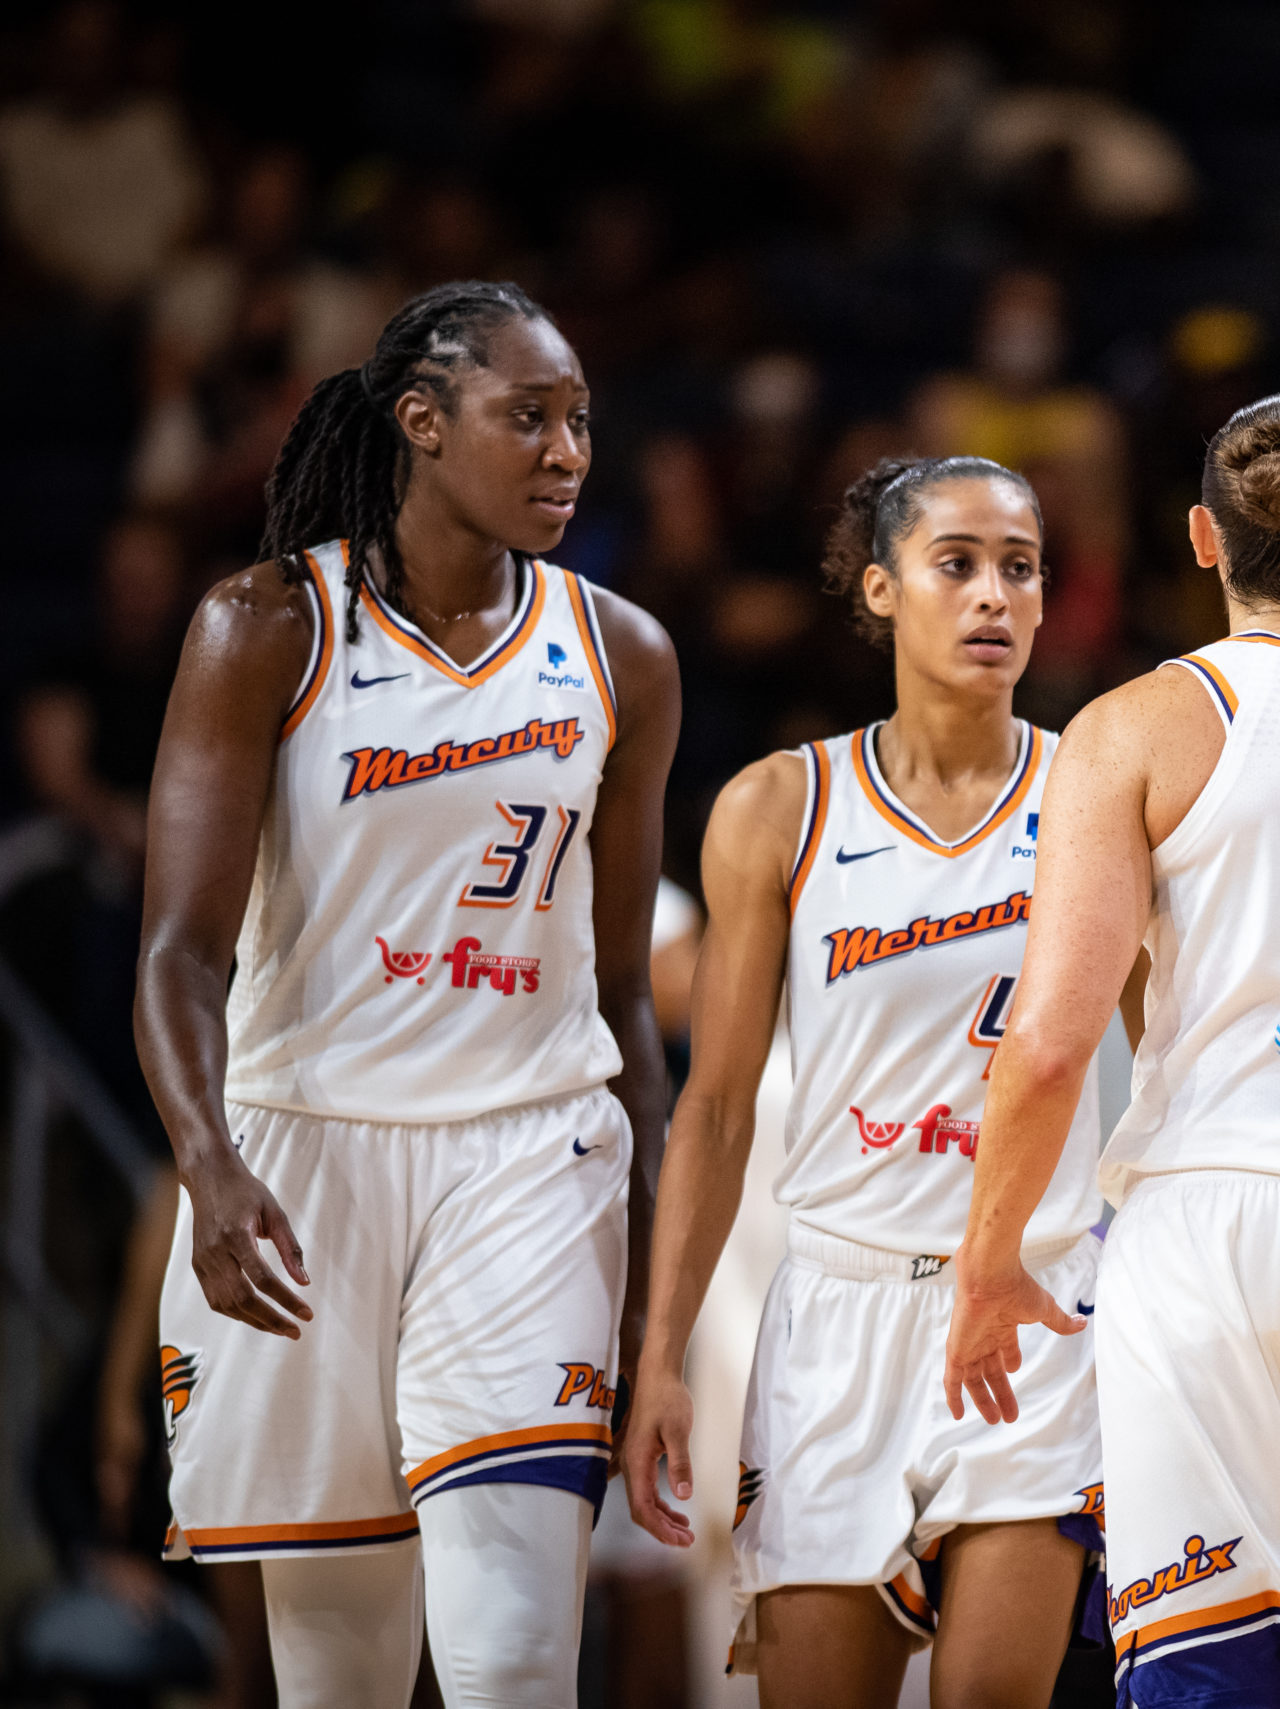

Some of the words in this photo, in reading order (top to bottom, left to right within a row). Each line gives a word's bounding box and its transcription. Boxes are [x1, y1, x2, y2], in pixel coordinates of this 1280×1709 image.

[539, 672, 584, 688] PayPal
[341, 716, 584, 804] Mercury
[458, 801, 582, 912] 31
[442, 936, 541, 996] fry's
[469, 955, 498, 966] FOOD
[501, 957, 538, 968] STORES
